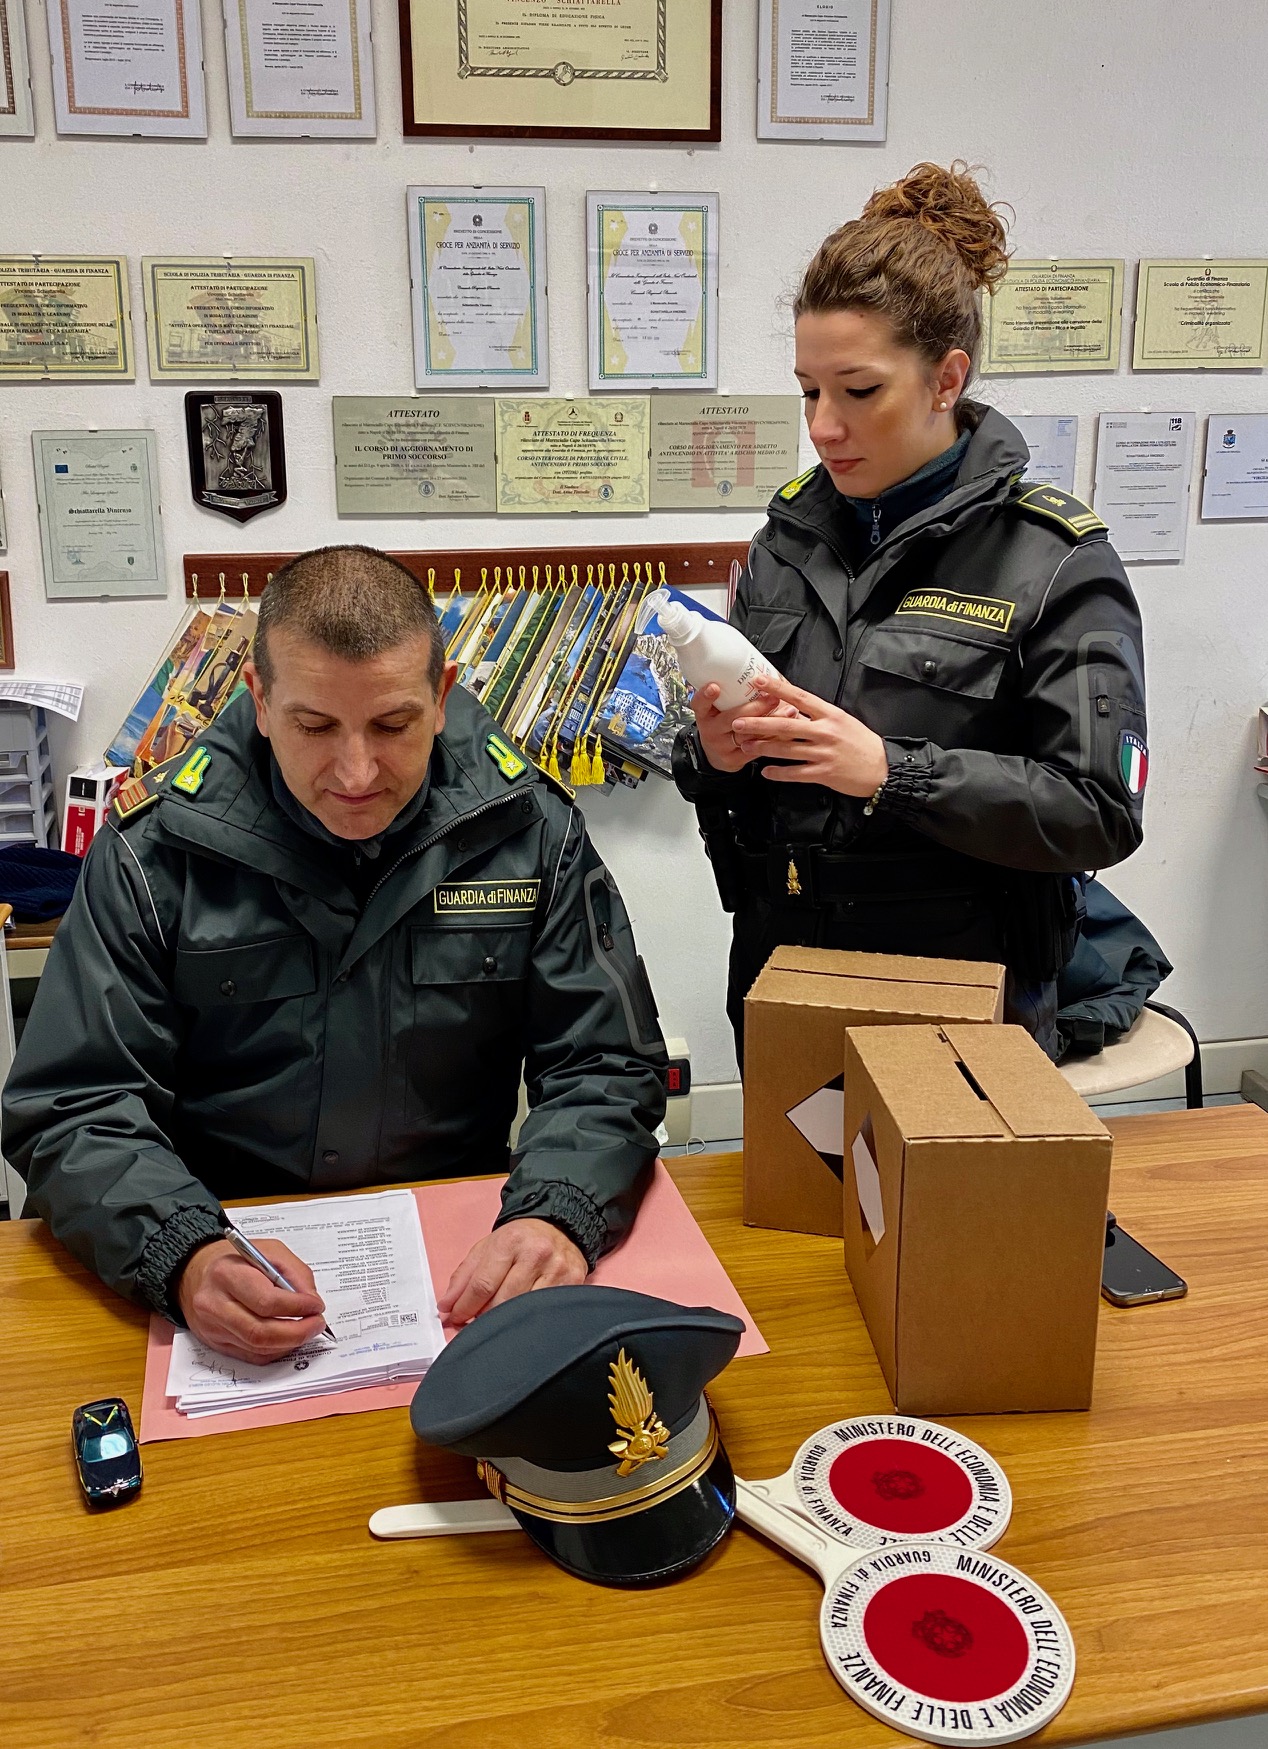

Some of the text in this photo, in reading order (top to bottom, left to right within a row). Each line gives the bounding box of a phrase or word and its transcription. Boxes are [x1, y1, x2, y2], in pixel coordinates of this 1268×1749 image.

[641, 248, 665, 256] ANZIANITÀ
[387, 410, 440, 418] ATTESTATO
[903, 595, 1005, 624] GUARDIA di FINANZA
[1126, 736, 1146, 756] ITALIA
[439, 888, 536, 905] GUARDIA di FINANZA
[833, 1422, 916, 1443] MINISTERO
[801, 1444, 854, 1537] GUARDIA di FINANZA
[984, 1505, 998, 1516] E
[948, 1514, 993, 1545] DELLE
[831, 1550, 931, 1629] GUARDIA di FINANZA
[956, 1554, 1043, 1615] MINISTERO
[838, 1651, 906, 1712] FINANZE
[911, 1700, 973, 1730] DELLE
[979, 1707, 995, 1729] E
